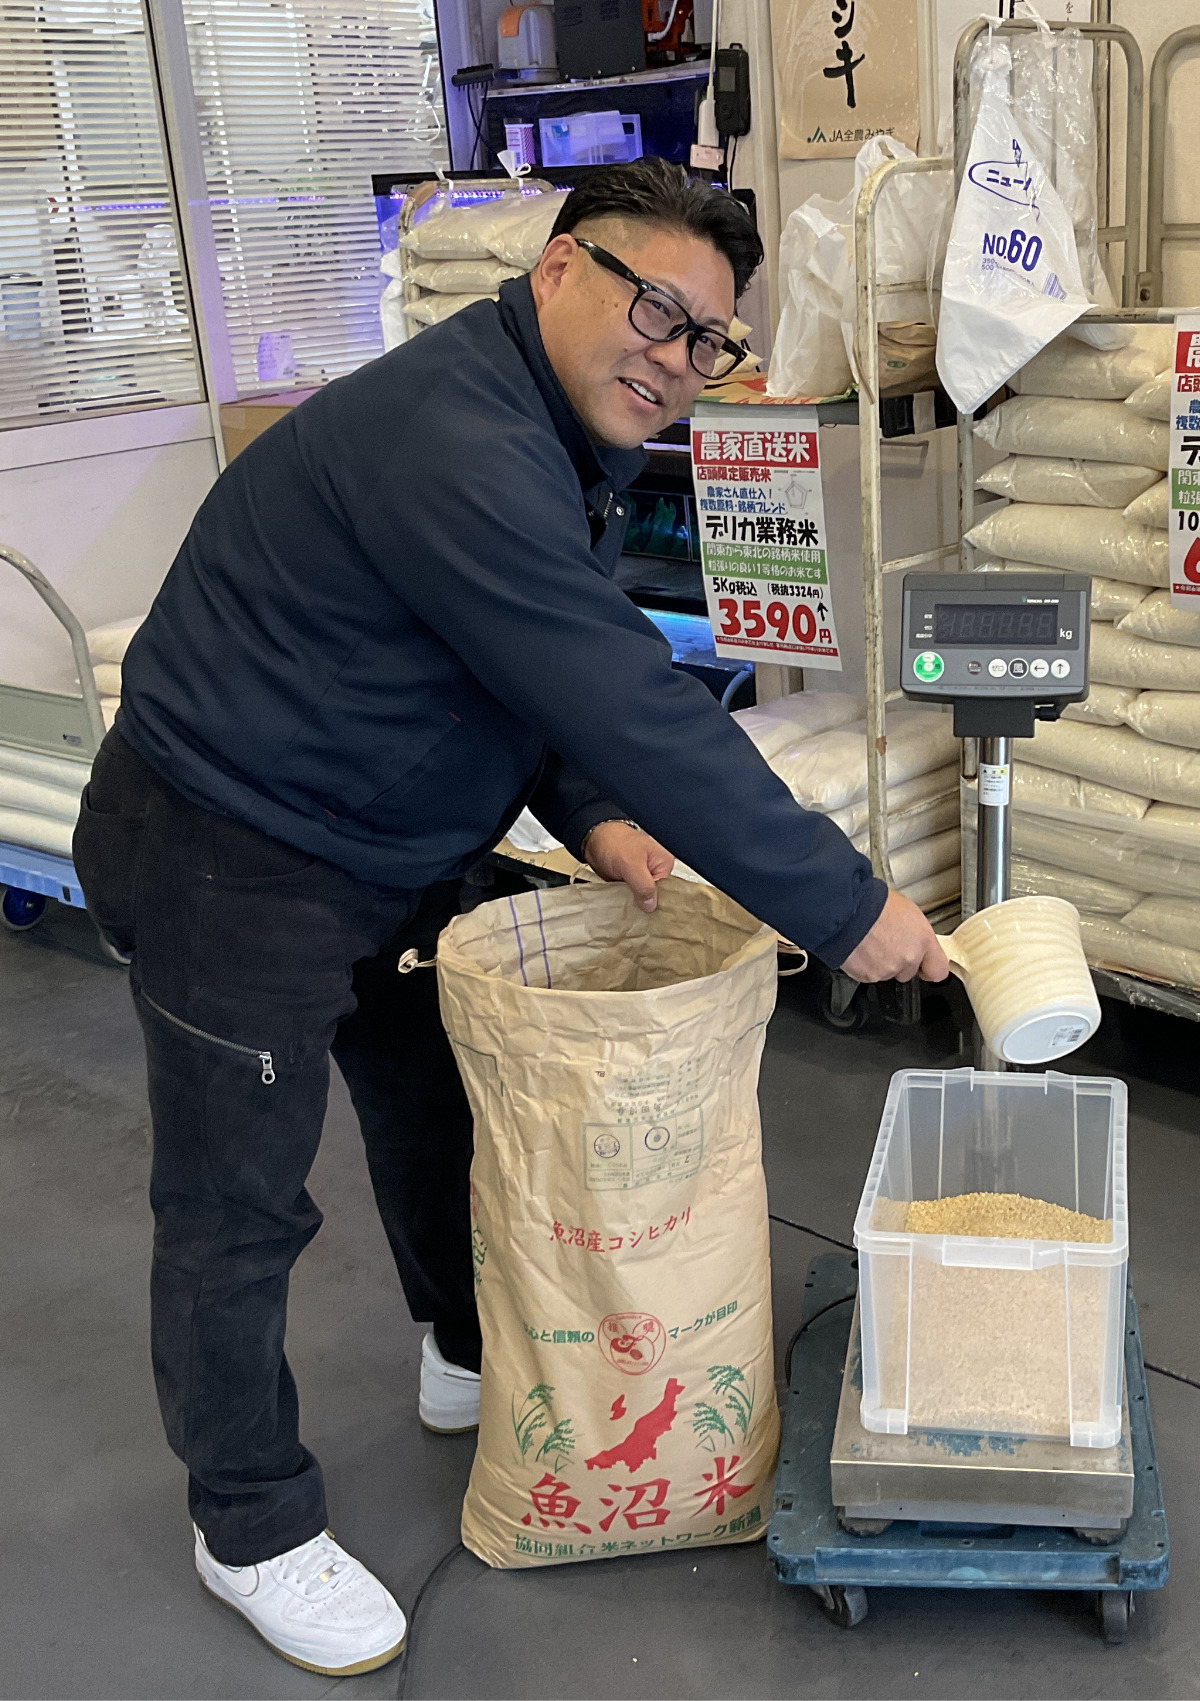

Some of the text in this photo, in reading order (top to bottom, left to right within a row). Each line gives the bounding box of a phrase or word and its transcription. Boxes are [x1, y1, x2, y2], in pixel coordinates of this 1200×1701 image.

[700, 430, 810, 463] 農家直送米
[697, 466, 772, 483] 店頭限定販売米
[706, 515, 818, 547] デリカ業務米
[1059, 628, 1073, 640] kg
[550, 1206, 691, 1252] 魚沼産コシヒカリ
[667, 1300, 738, 1340] マークが目印
[521, 1455, 755, 1535] 魚沼米
